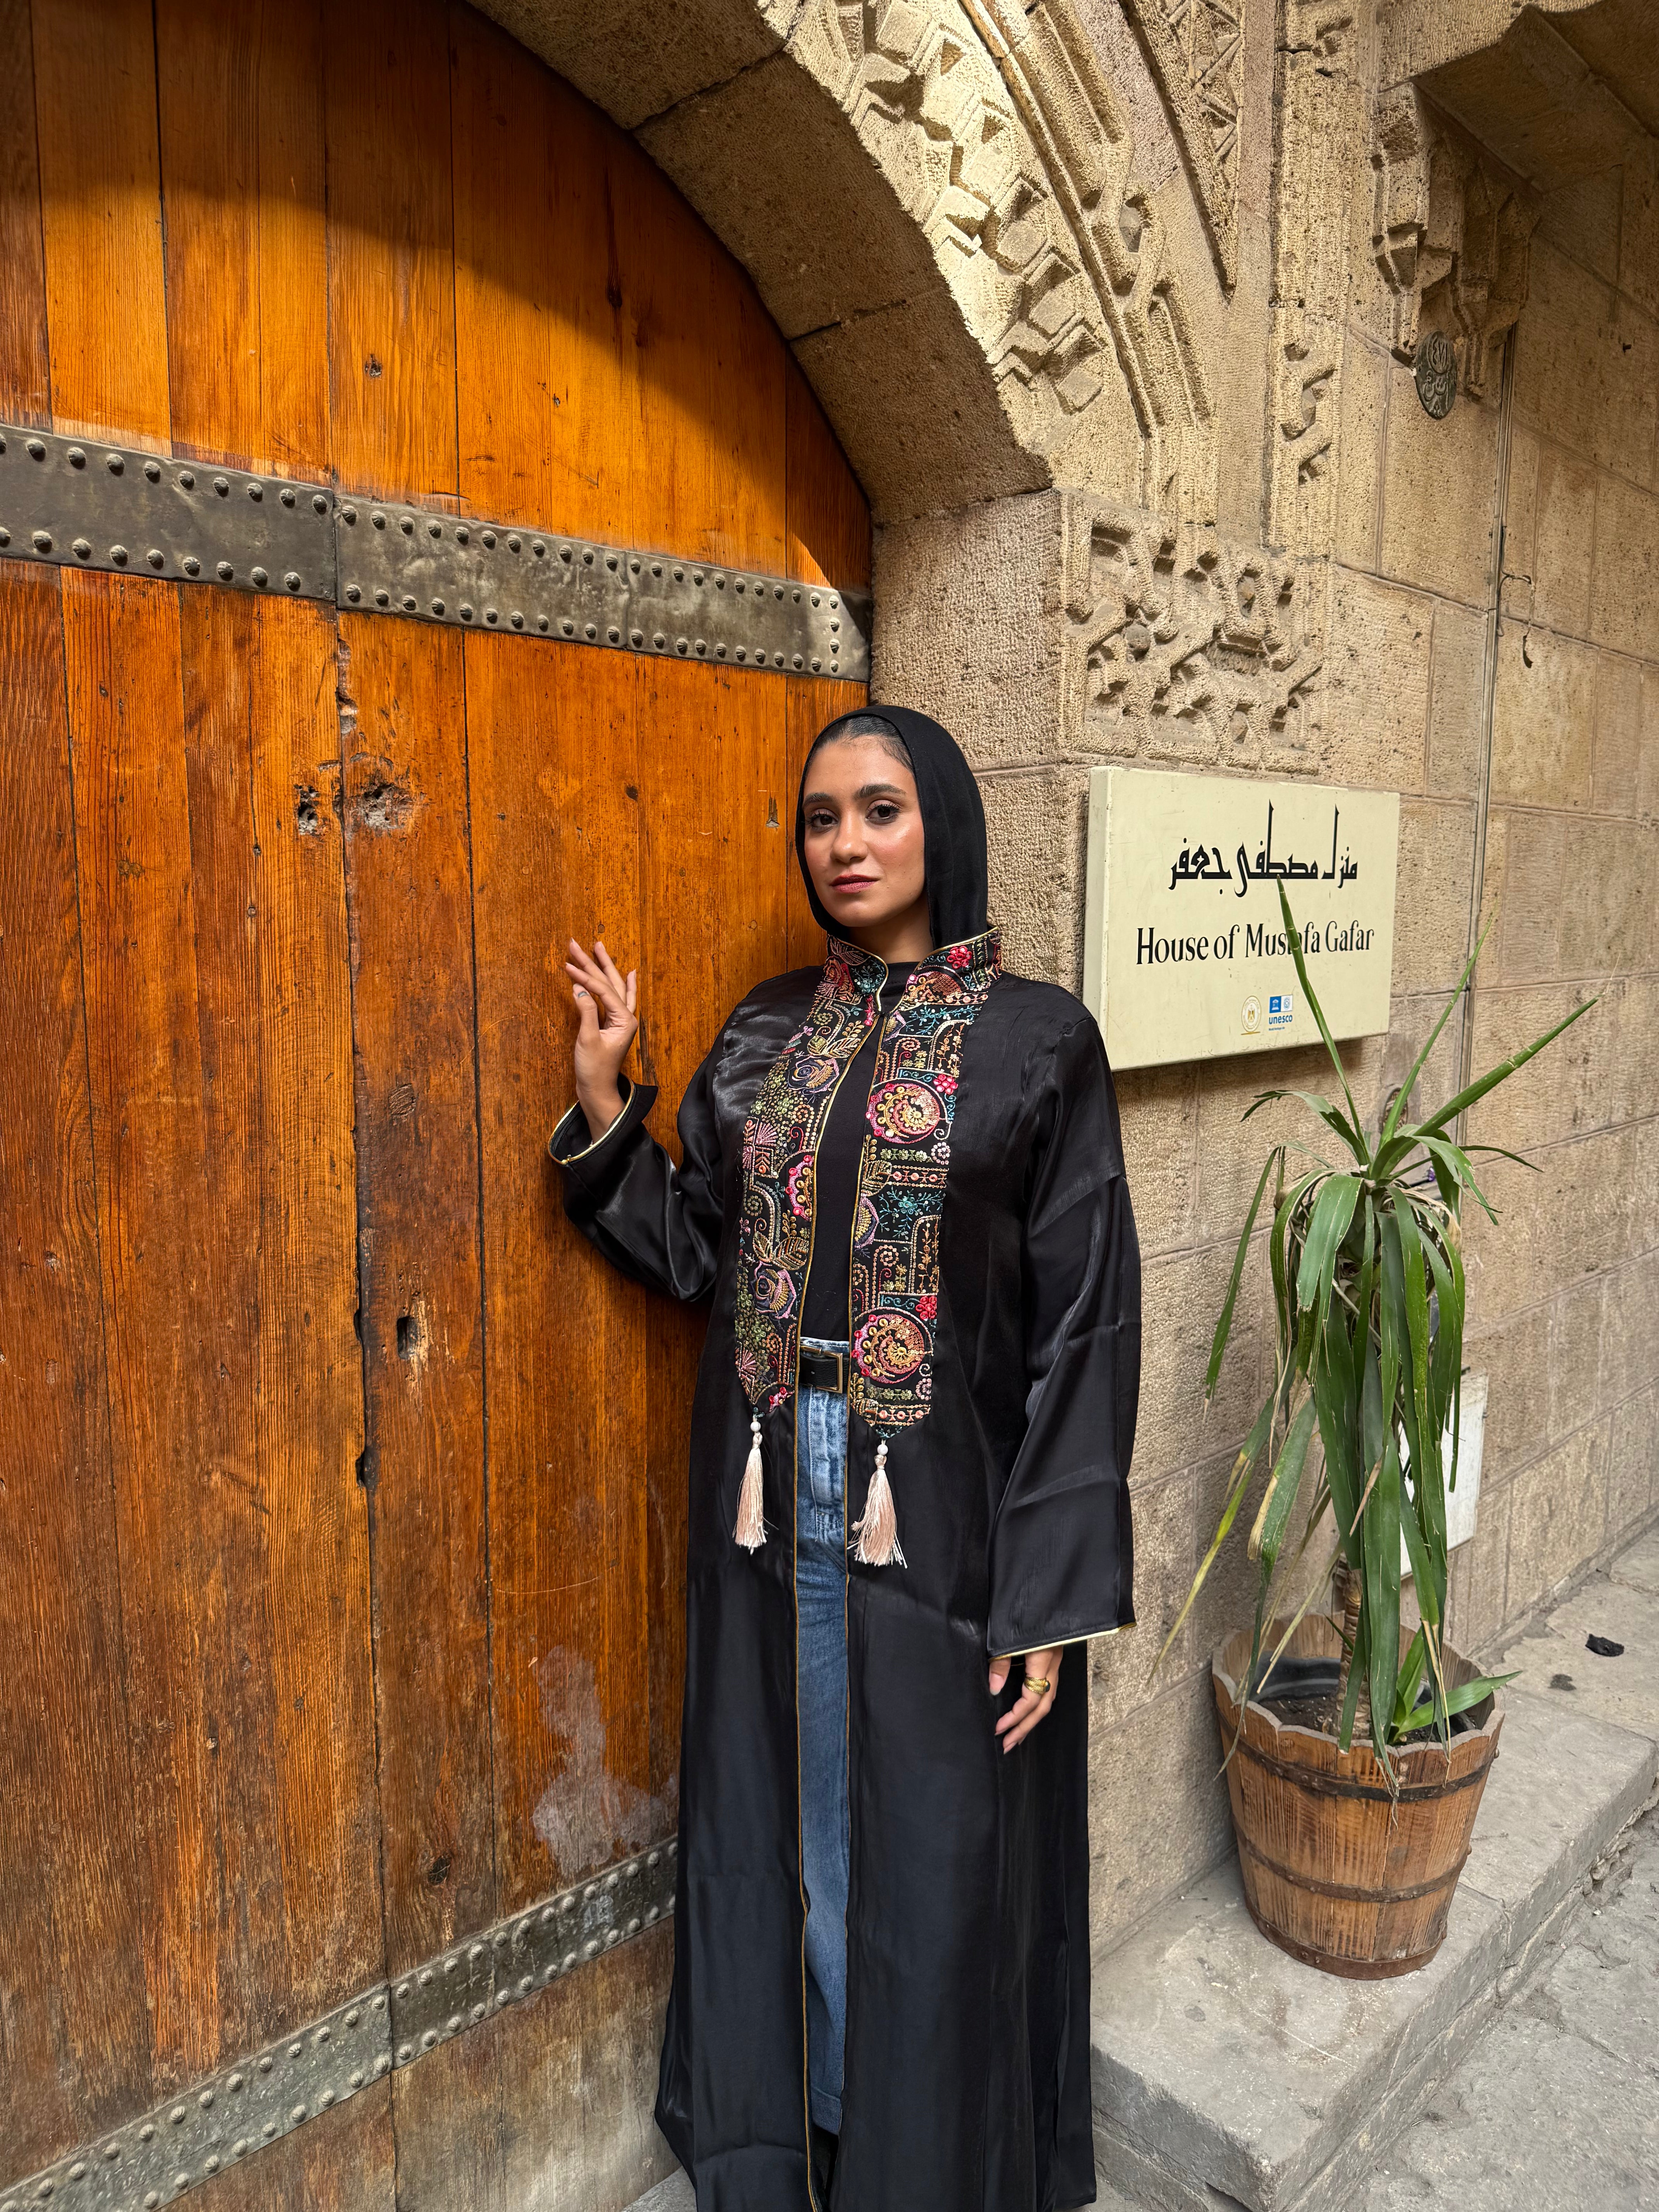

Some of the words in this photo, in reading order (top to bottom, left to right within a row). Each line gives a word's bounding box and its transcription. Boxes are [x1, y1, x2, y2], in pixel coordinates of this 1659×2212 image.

[1168, 837, 1233, 895] جعفر
[1321, 803, 1358, 889] منزل
[1136, 927, 1209, 965] House
[1213, 924, 1240, 960] of
[1245, 921, 1321, 958] Musfa
[1325, 920, 1374, 952] Gafar
[1268, 1014, 1293, 1025] unesco
